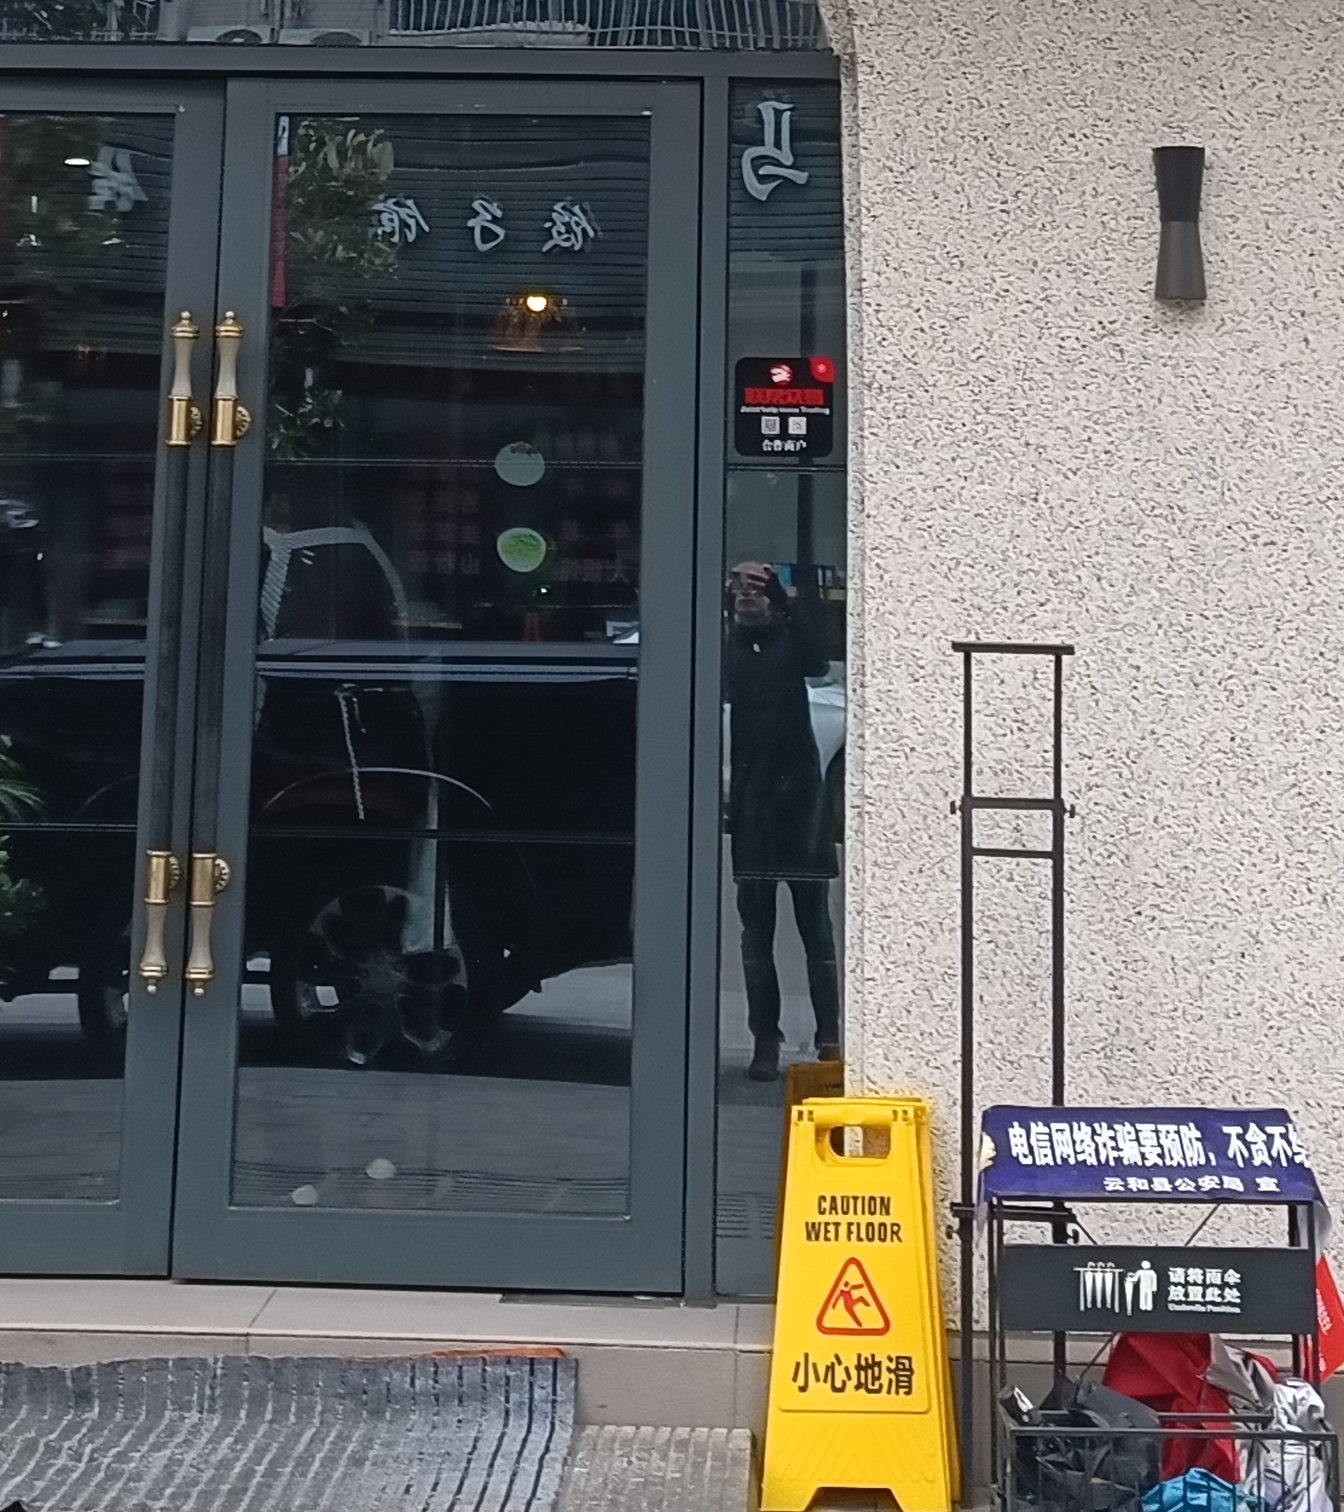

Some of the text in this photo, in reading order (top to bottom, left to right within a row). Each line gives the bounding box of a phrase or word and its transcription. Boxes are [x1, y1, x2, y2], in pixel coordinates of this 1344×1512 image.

[1103, 1175, 1281, 1193] 云和县公安局 宣
[817, 1195, 892, 1217] CAUTION
[805, 1221, 903, 1243] WET FLOOR
[1167, 1266, 1242, 1285] 请将雨伞
[1167, 1285, 1242, 1303] 放置此处
[791, 1351, 915, 1397] 小心地滑
